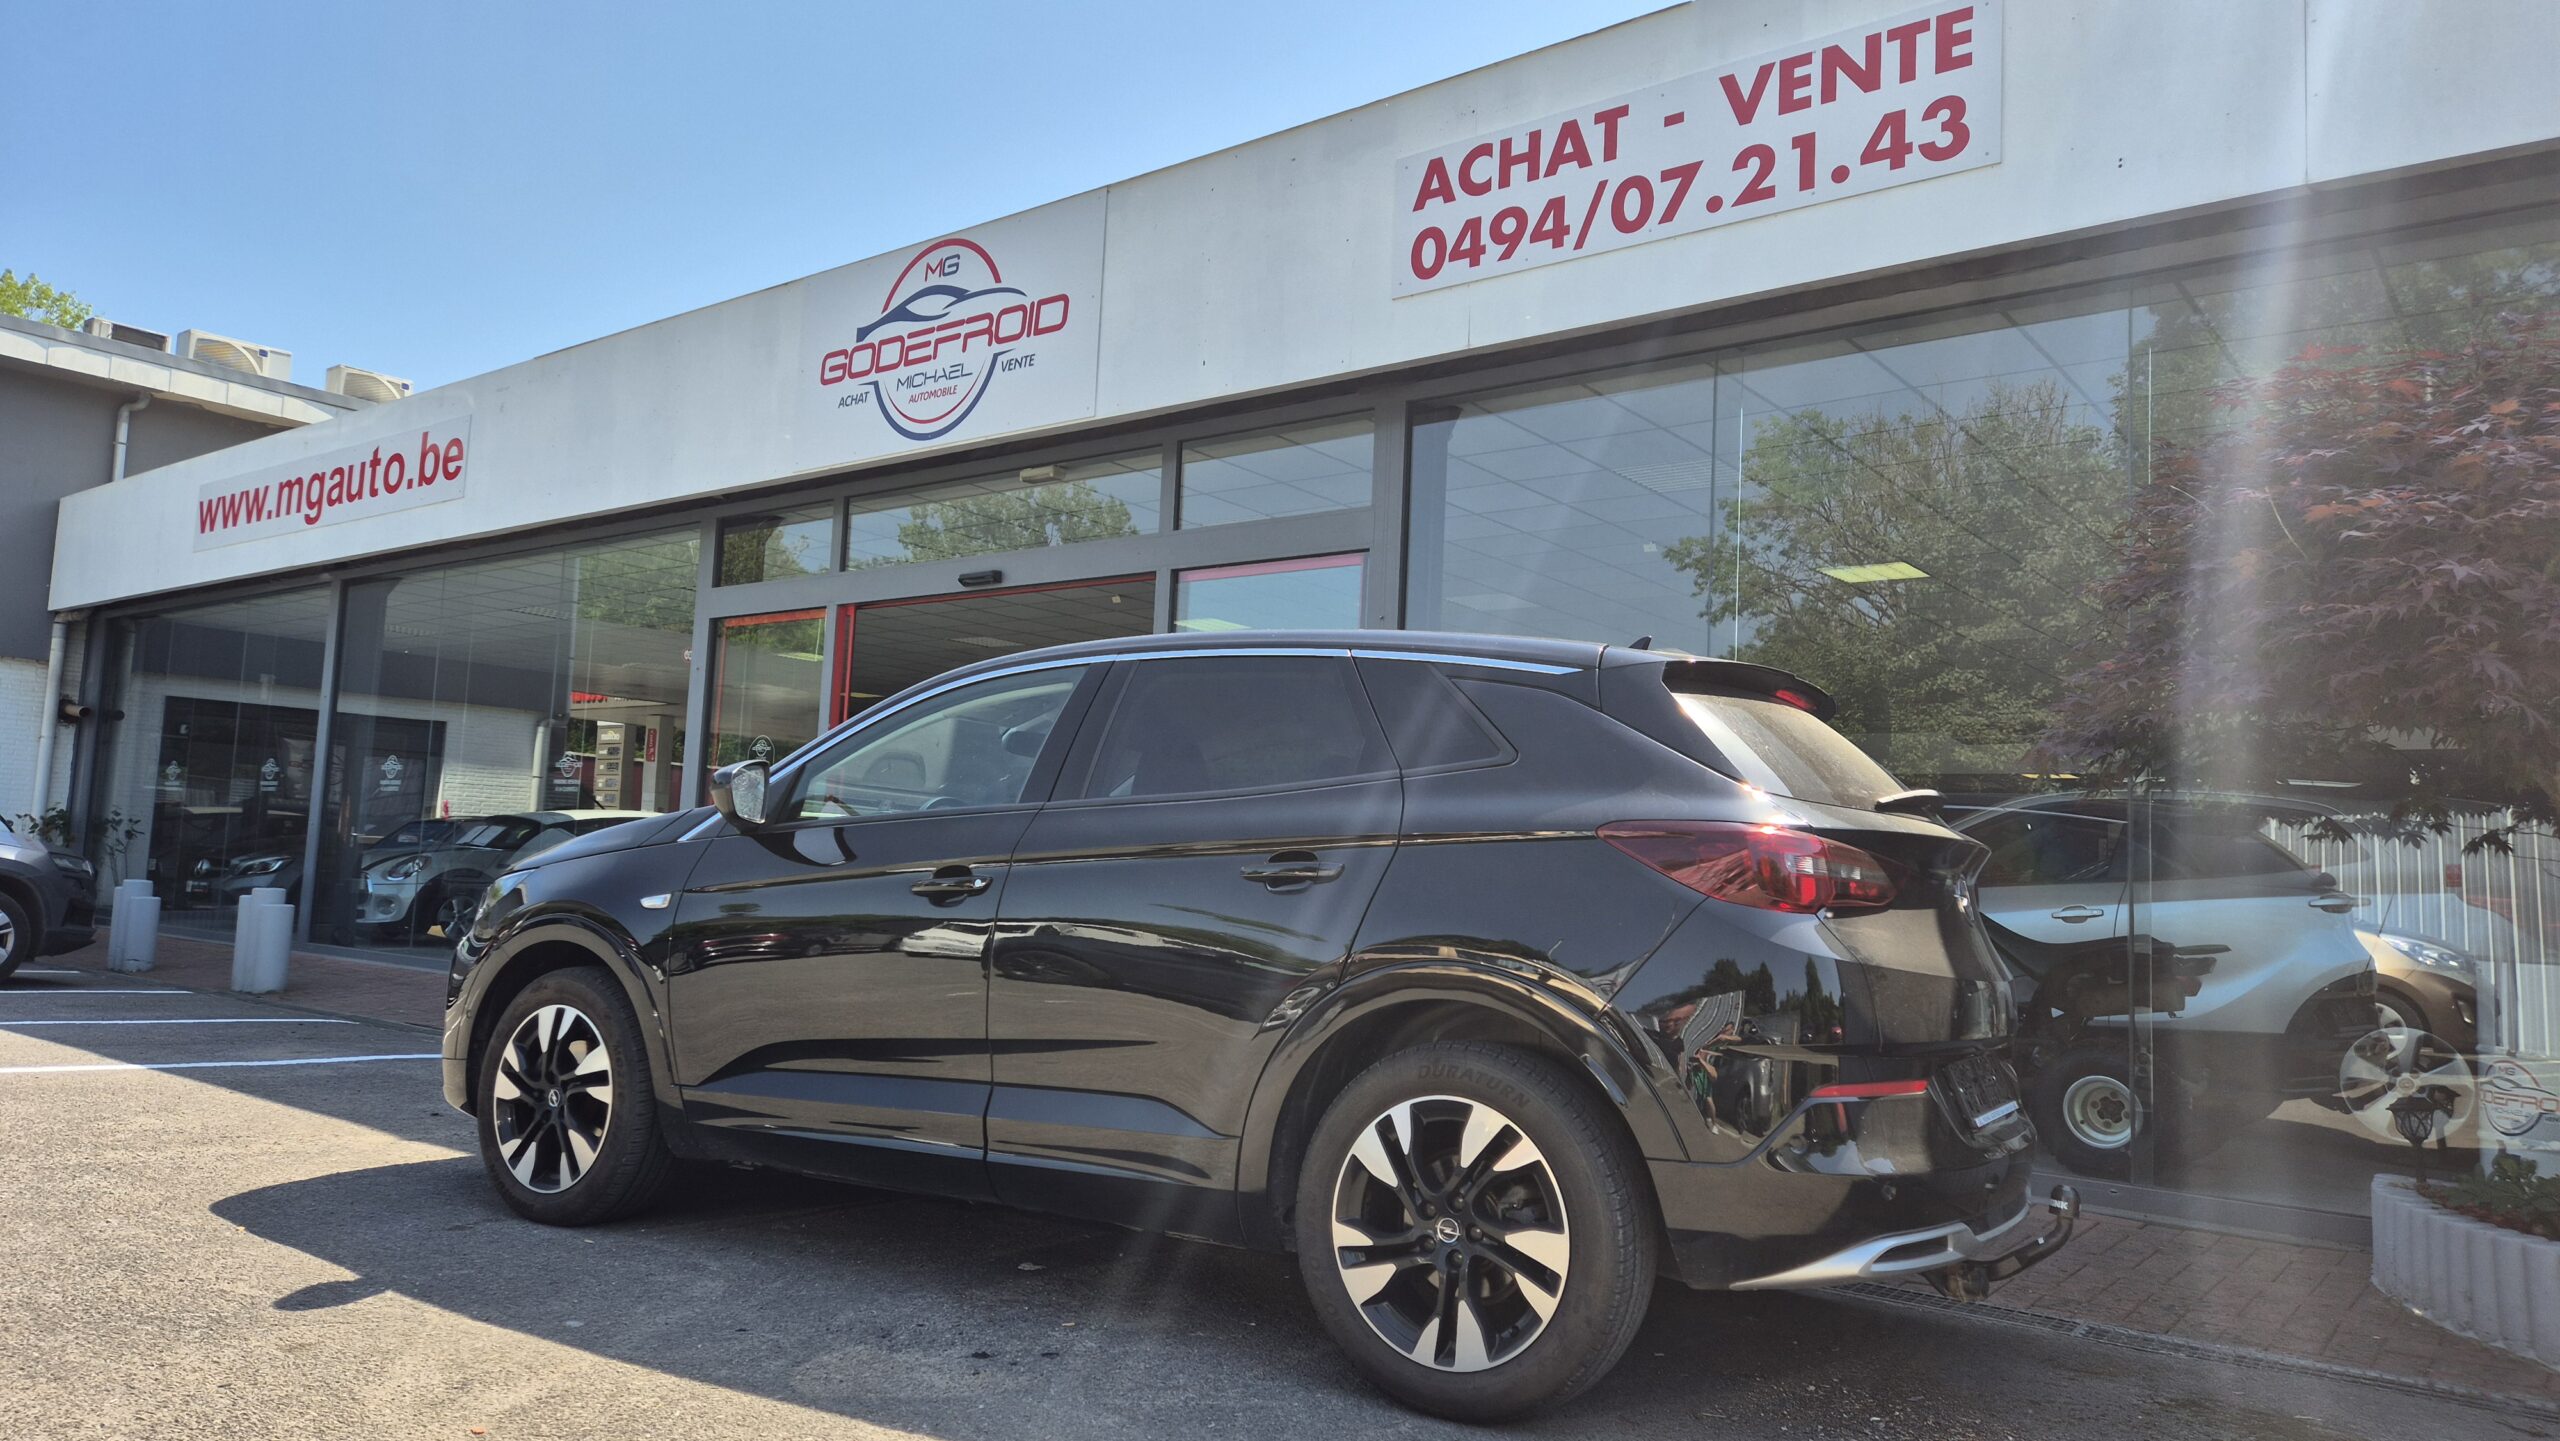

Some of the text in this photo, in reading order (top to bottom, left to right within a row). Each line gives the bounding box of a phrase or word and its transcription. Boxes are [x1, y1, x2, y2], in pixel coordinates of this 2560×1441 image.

[1412, 6, 1974, 212] ACHAT - VENTE
[1410, 94, 1971, 280] 0494/07.21.43
[924, 253, 960, 282] MG
[820, 293, 1070, 386] GODEFROID
[896, 363, 973, 392] MICHAEL
[1001, 353, 1036, 373] VENTE
[837, 391, 870, 409] ACHAT
[908, 385, 958, 404] AUTOMOBILE
[199, 431, 464, 535] www.mgauto.be
[1418, 1064, 1530, 1108] DURATURN
